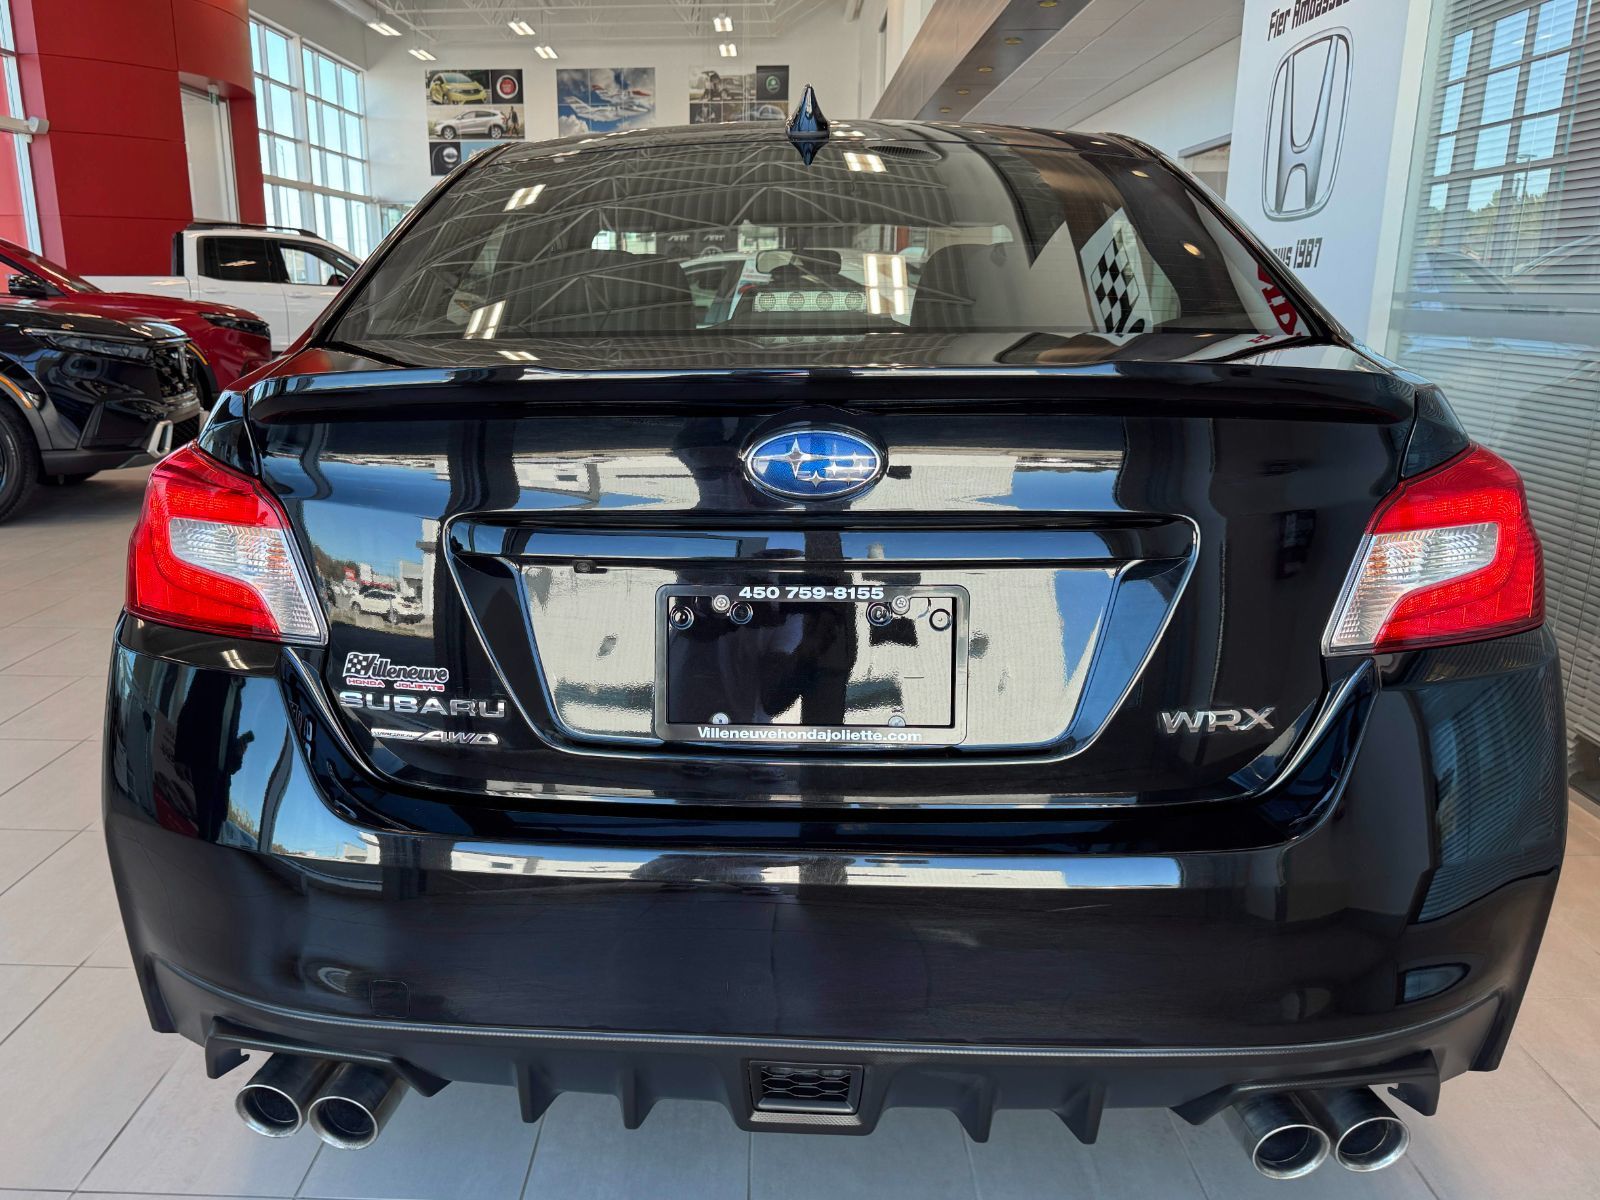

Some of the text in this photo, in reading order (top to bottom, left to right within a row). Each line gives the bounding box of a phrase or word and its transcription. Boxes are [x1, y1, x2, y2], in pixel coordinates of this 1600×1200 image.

[1267, 8, 1291, 41] Fier
[1293, 237, 1323, 269] 1987
[738, 586, 885, 600] 450 759-8155
[344, 652, 449, 683] Villeneuve
[347, 678, 445, 692] HONDA JOLIETTE
[339, 691, 505, 718] SUBARU
[1161, 706, 1276, 734] WRX
[417, 730, 499, 745] AWD
[697, 726, 922, 743] Villeneuvehondajoliette.com
